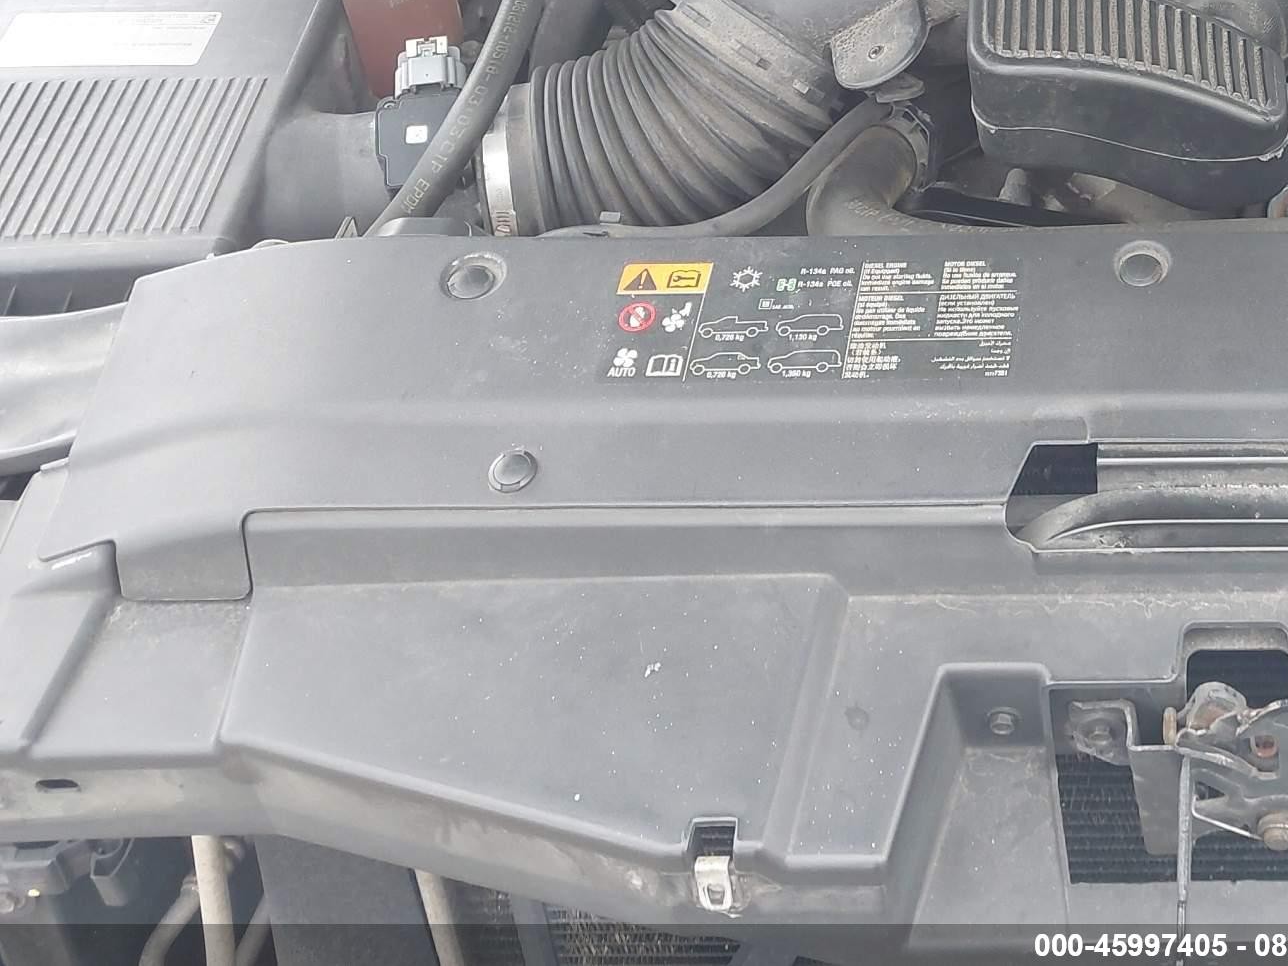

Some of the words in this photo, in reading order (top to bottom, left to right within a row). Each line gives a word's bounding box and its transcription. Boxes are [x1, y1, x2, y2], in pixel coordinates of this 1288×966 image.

[735, 334, 745, 342] kg
[808, 333, 818, 342] kg
[607, 366, 636, 377] AUTO
[726, 371, 737, 379] kg
[801, 370, 811, 378] kg
